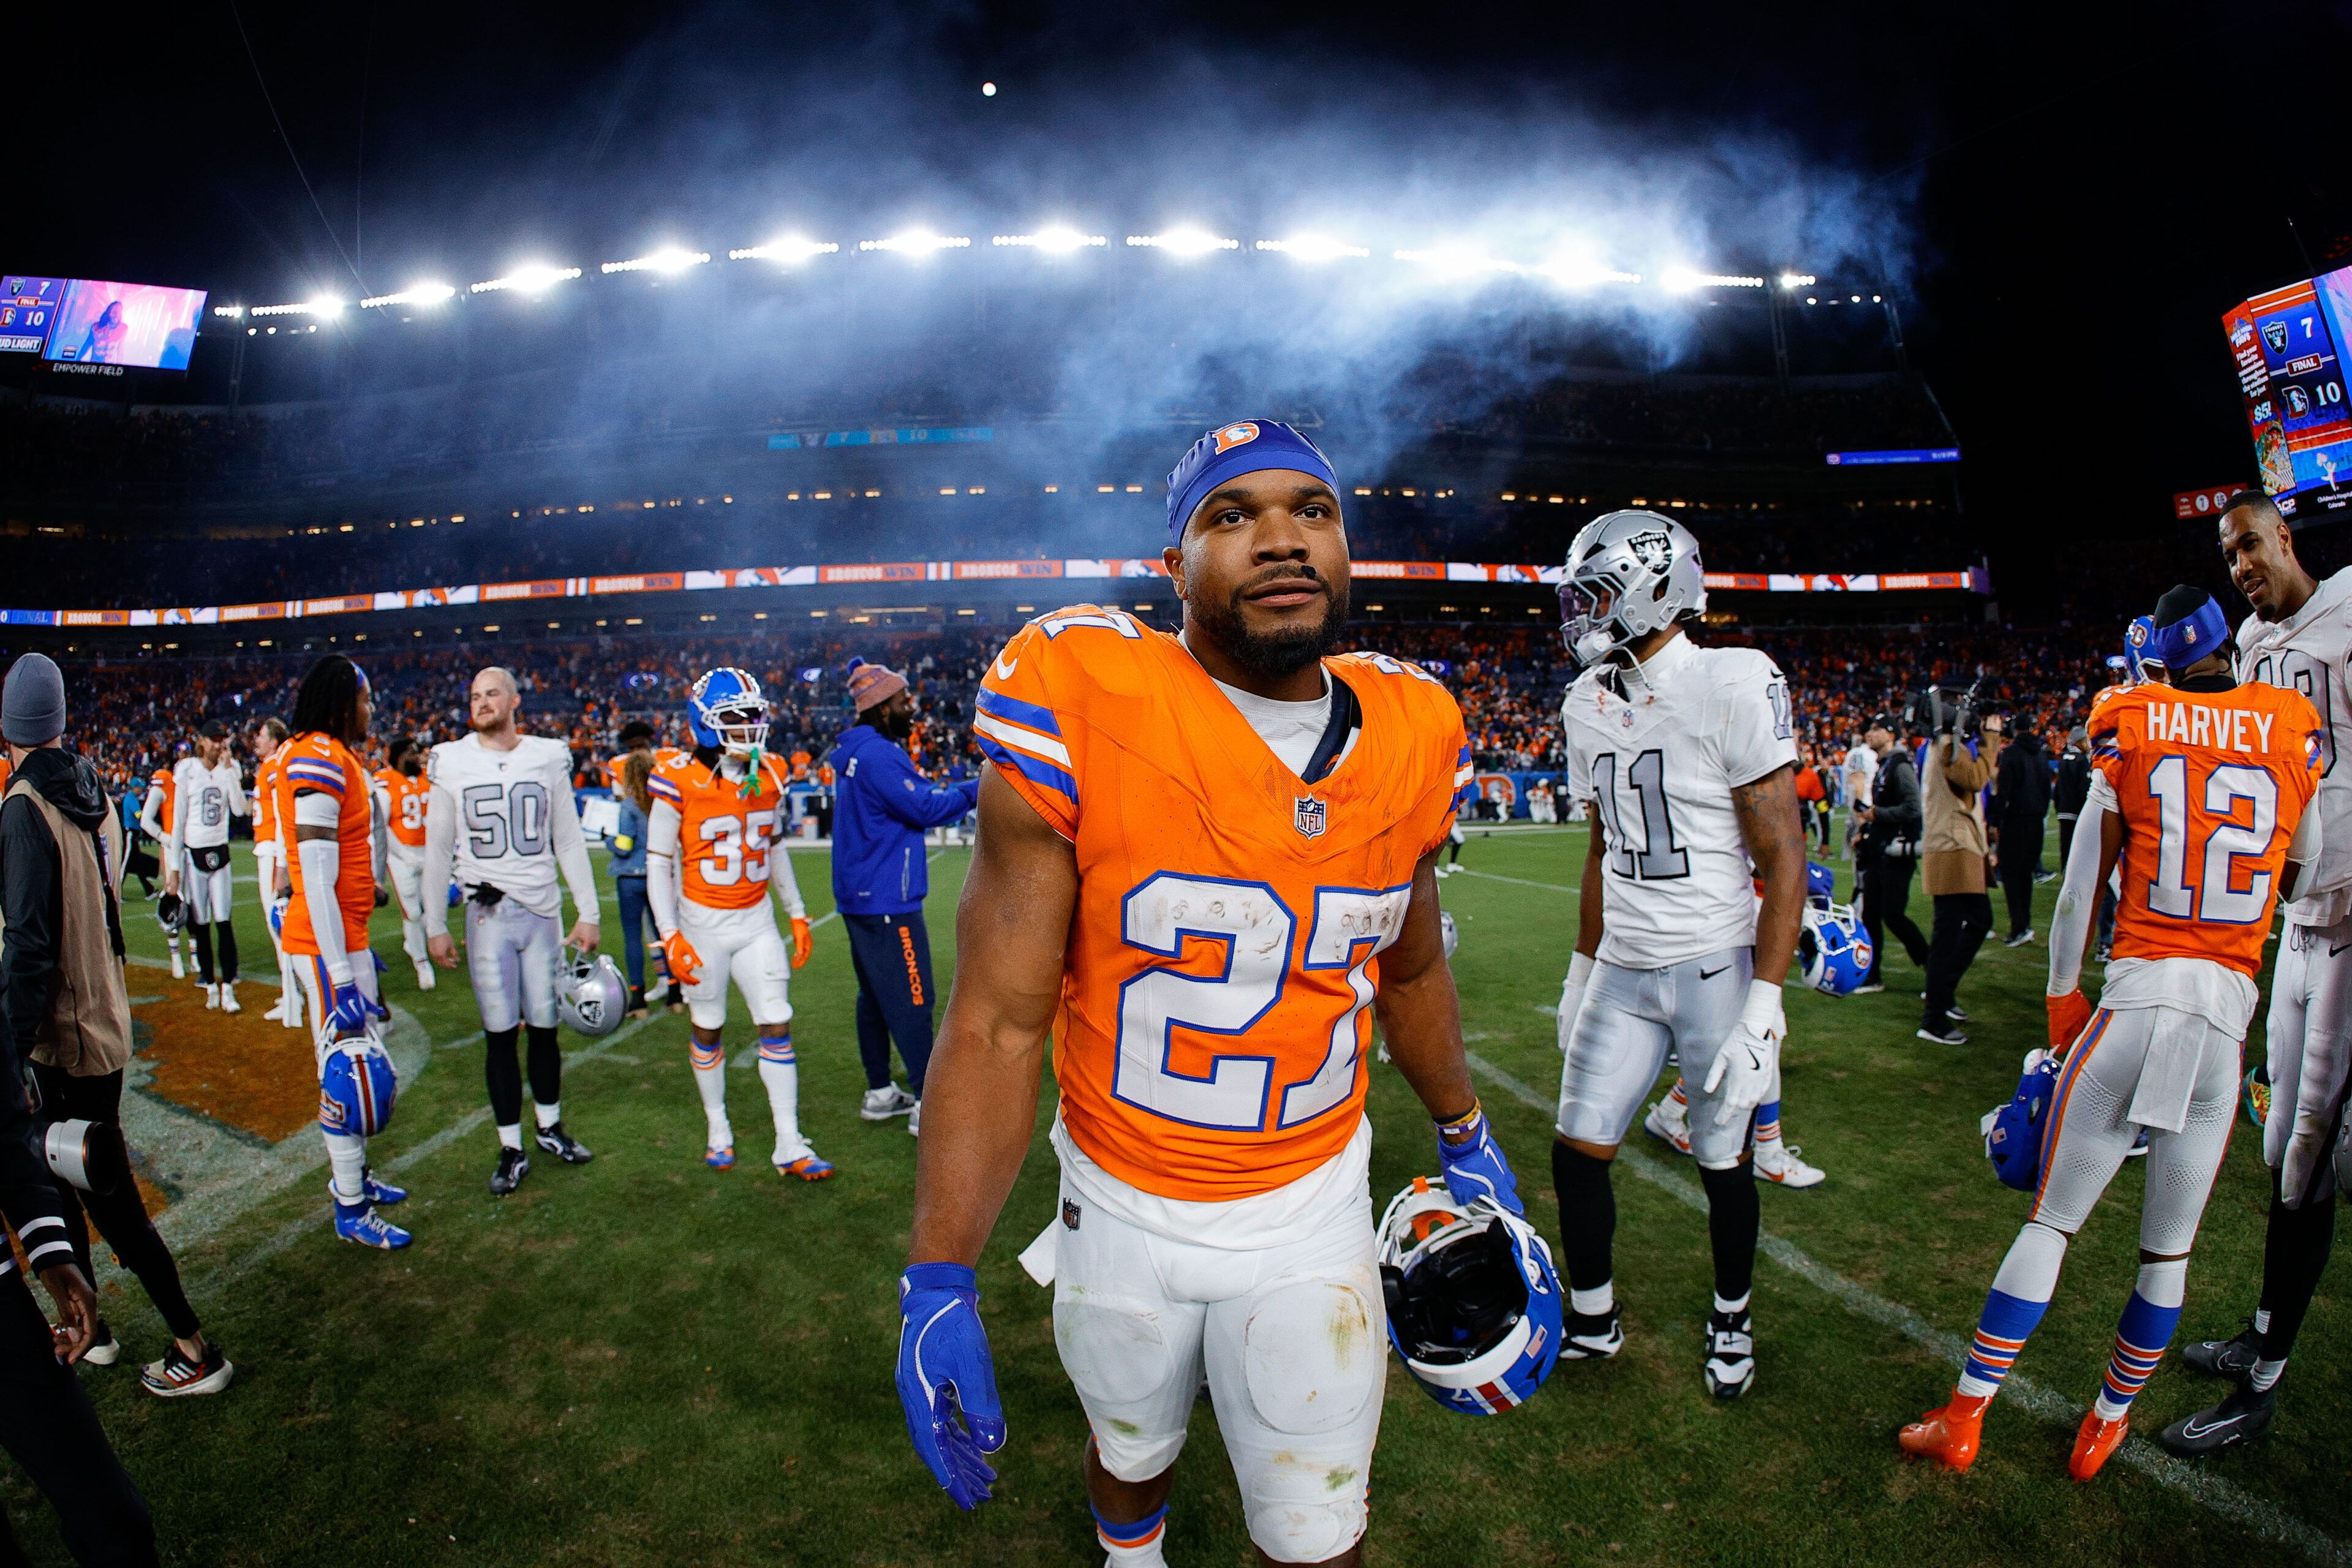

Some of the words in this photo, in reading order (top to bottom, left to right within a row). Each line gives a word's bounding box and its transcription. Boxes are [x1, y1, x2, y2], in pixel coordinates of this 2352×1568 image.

[39, 281, 51, 295] 7
[26, 311, 45, 326] 10
[2301, 317, 2313, 338] 7
[12, 338, 40, 349] LIGHT
[53, 363, 97, 374] EMPOWER
[98, 366, 124, 377] FIELD
[2291, 358, 2317, 372] FINAL
[2316, 382, 2340, 405] 10
[2254, 401, 2272, 423] $5!
[884, 567, 918, 578] WIN
[1019, 564, 1053, 576] WIN
[2147, 702, 2274, 754] HARVEY
[202, 787, 221, 826] 6
[1593, 748, 1691, 881] 11
[464, 782, 548, 859] 50
[1299, 813, 1321, 831] NFL
[699, 810, 776, 886] 35
[2147, 755, 2278, 925] 12
[899, 926, 924, 1006] BRONCOS
[1111, 869, 1412, 1133] 27
